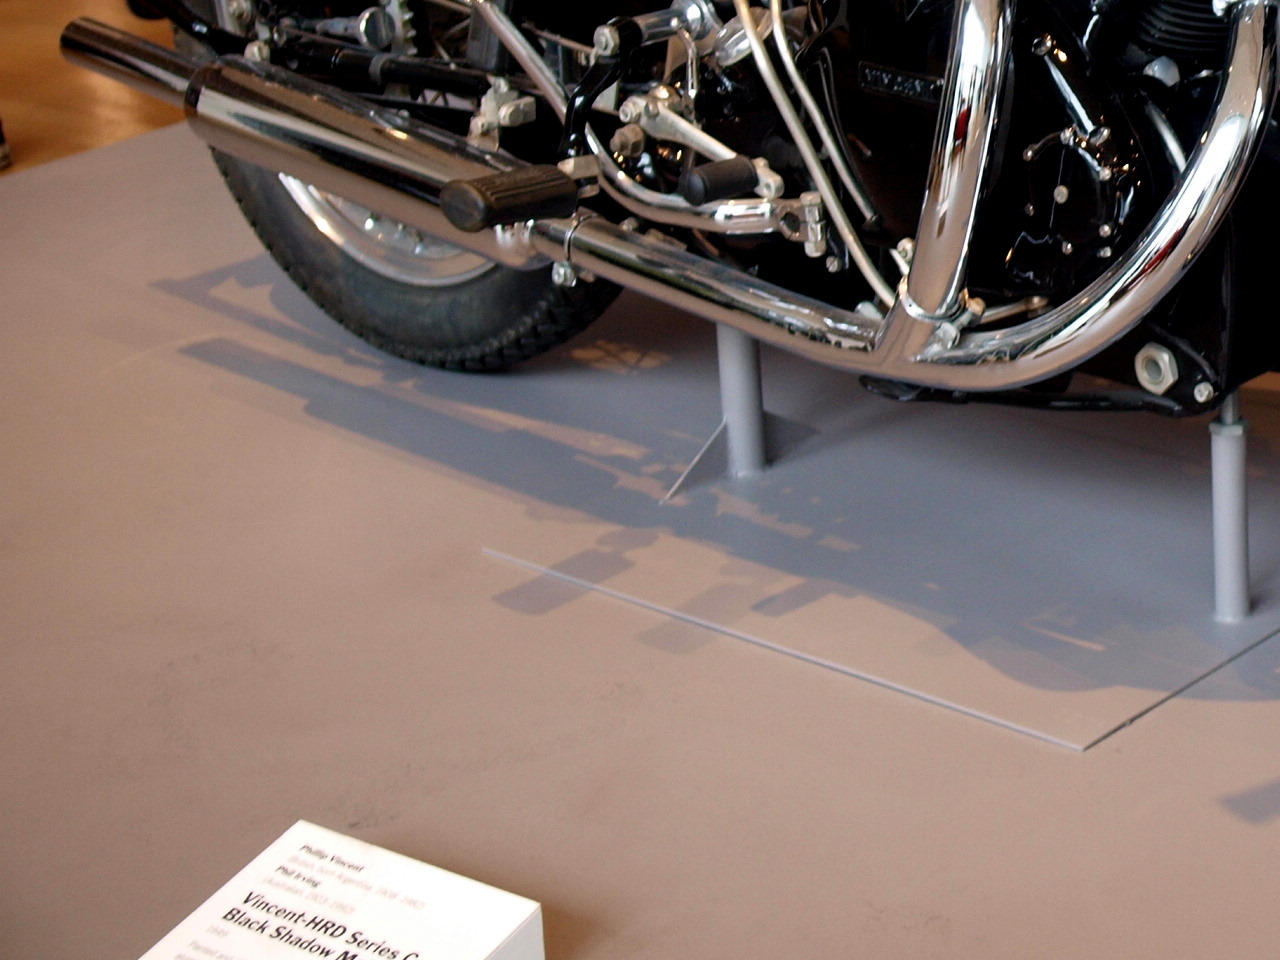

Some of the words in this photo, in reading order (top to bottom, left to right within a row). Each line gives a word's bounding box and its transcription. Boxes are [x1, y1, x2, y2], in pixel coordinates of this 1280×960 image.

[330, 855, 365, 872] Vincent
[222, 907, 272, 934] Black
[269, 926, 336, 958] Shadow
[243, 892, 347, 938] Vincent-HRD
[345, 931, 400, 960] Series
